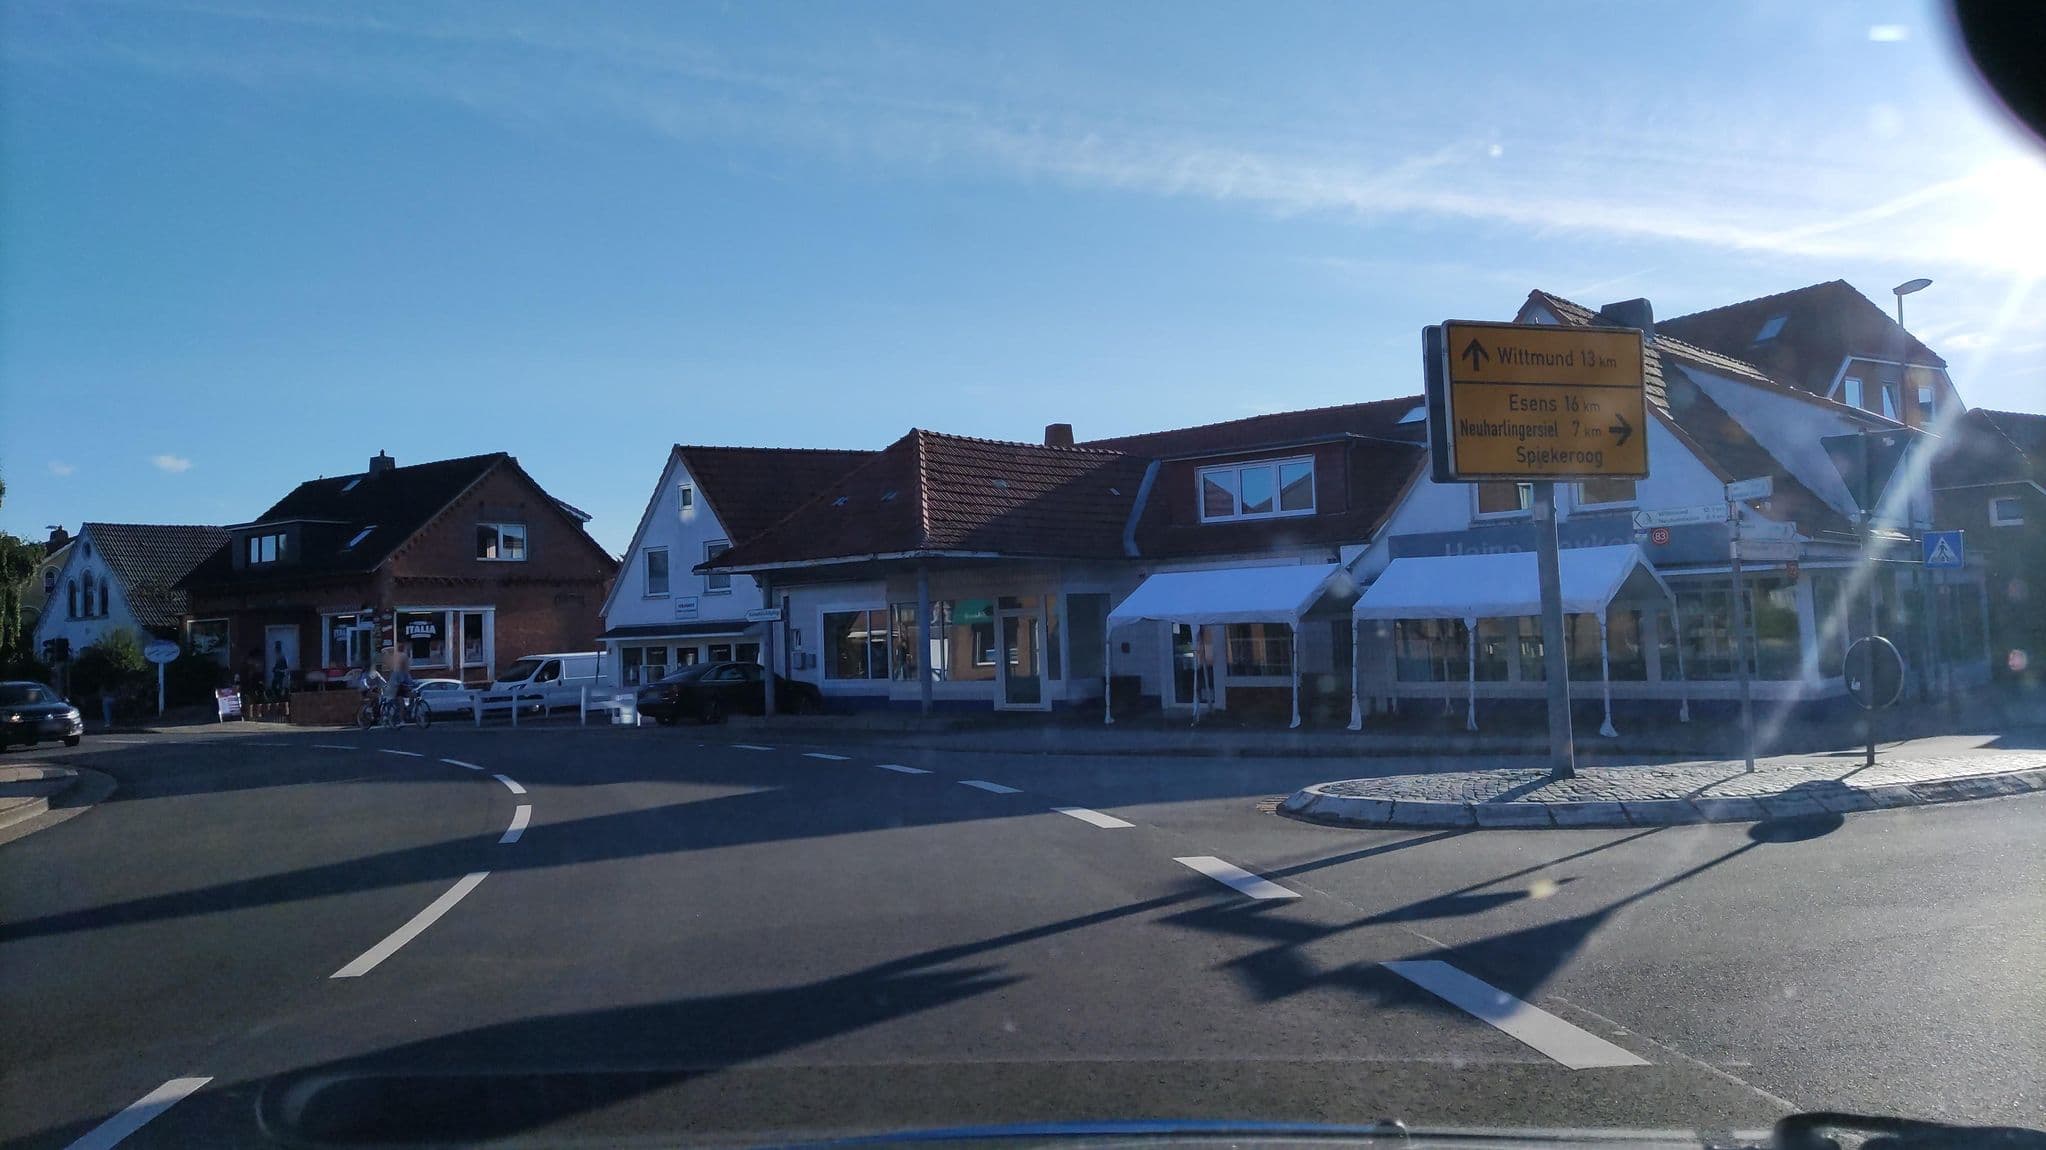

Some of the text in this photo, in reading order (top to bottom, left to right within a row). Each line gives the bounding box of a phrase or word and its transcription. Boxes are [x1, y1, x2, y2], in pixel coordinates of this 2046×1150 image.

[1497, 346, 1617, 368] Wittmund 13 km
[1509, 393, 1600, 412] Esens 16 km
[1460, 418, 1601, 441] Neuharlingersiel 7 km
[1516, 446, 1603, 468] Spiekeroog
[1655, 532, 1666, 541] 83
[405, 624, 437, 636] ITALIA
